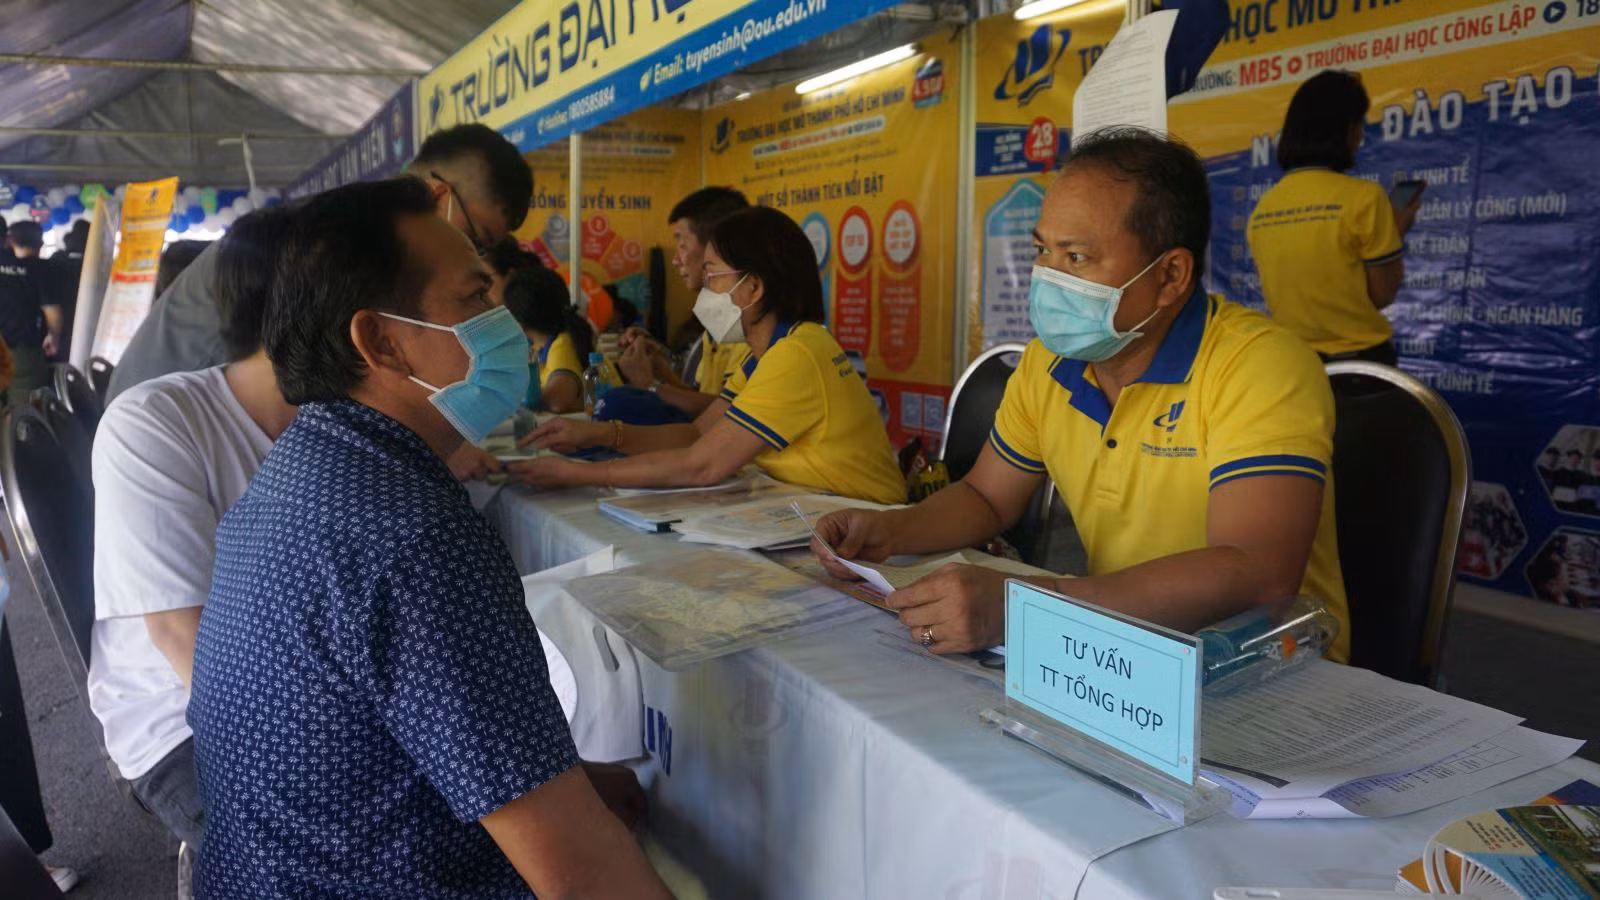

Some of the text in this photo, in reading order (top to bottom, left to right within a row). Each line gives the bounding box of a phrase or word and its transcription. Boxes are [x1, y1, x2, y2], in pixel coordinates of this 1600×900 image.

[450, 21, 550, 122] TRƯỜNG
[558, 0, 616, 74] ĐẠI
[653, 53, 684, 85] Email:
[686, 0, 827, 73] tuyensinh@ou.edu.vn
[1239, 55, 1282, 87] MBS
[1307, 40, 1368, 70] TRƯỜNG
[1372, 35, 1400, 60] ĐẠI
[1405, 26, 1439, 53] HỌC
[1443, 15, 1493, 43] CÔNG
[1499, 5, 1537, 35] LẬP
[1382, 66, 1575, 142] ĐÀO TẠO
[1032, 122, 1054, 148] 28
[580, 187, 614, 209] UYỂN
[619, 196, 652, 209] SINH
[1412, 155, 1470, 185] KINH TẾ
[1475, 194, 1516, 218] CÔNG
[1519, 189, 1567, 218] (MỚI)
[1062, 635, 1132, 680] TƯ VẤN
[1040, 664, 1163, 732] TT TỔNG HỢP
